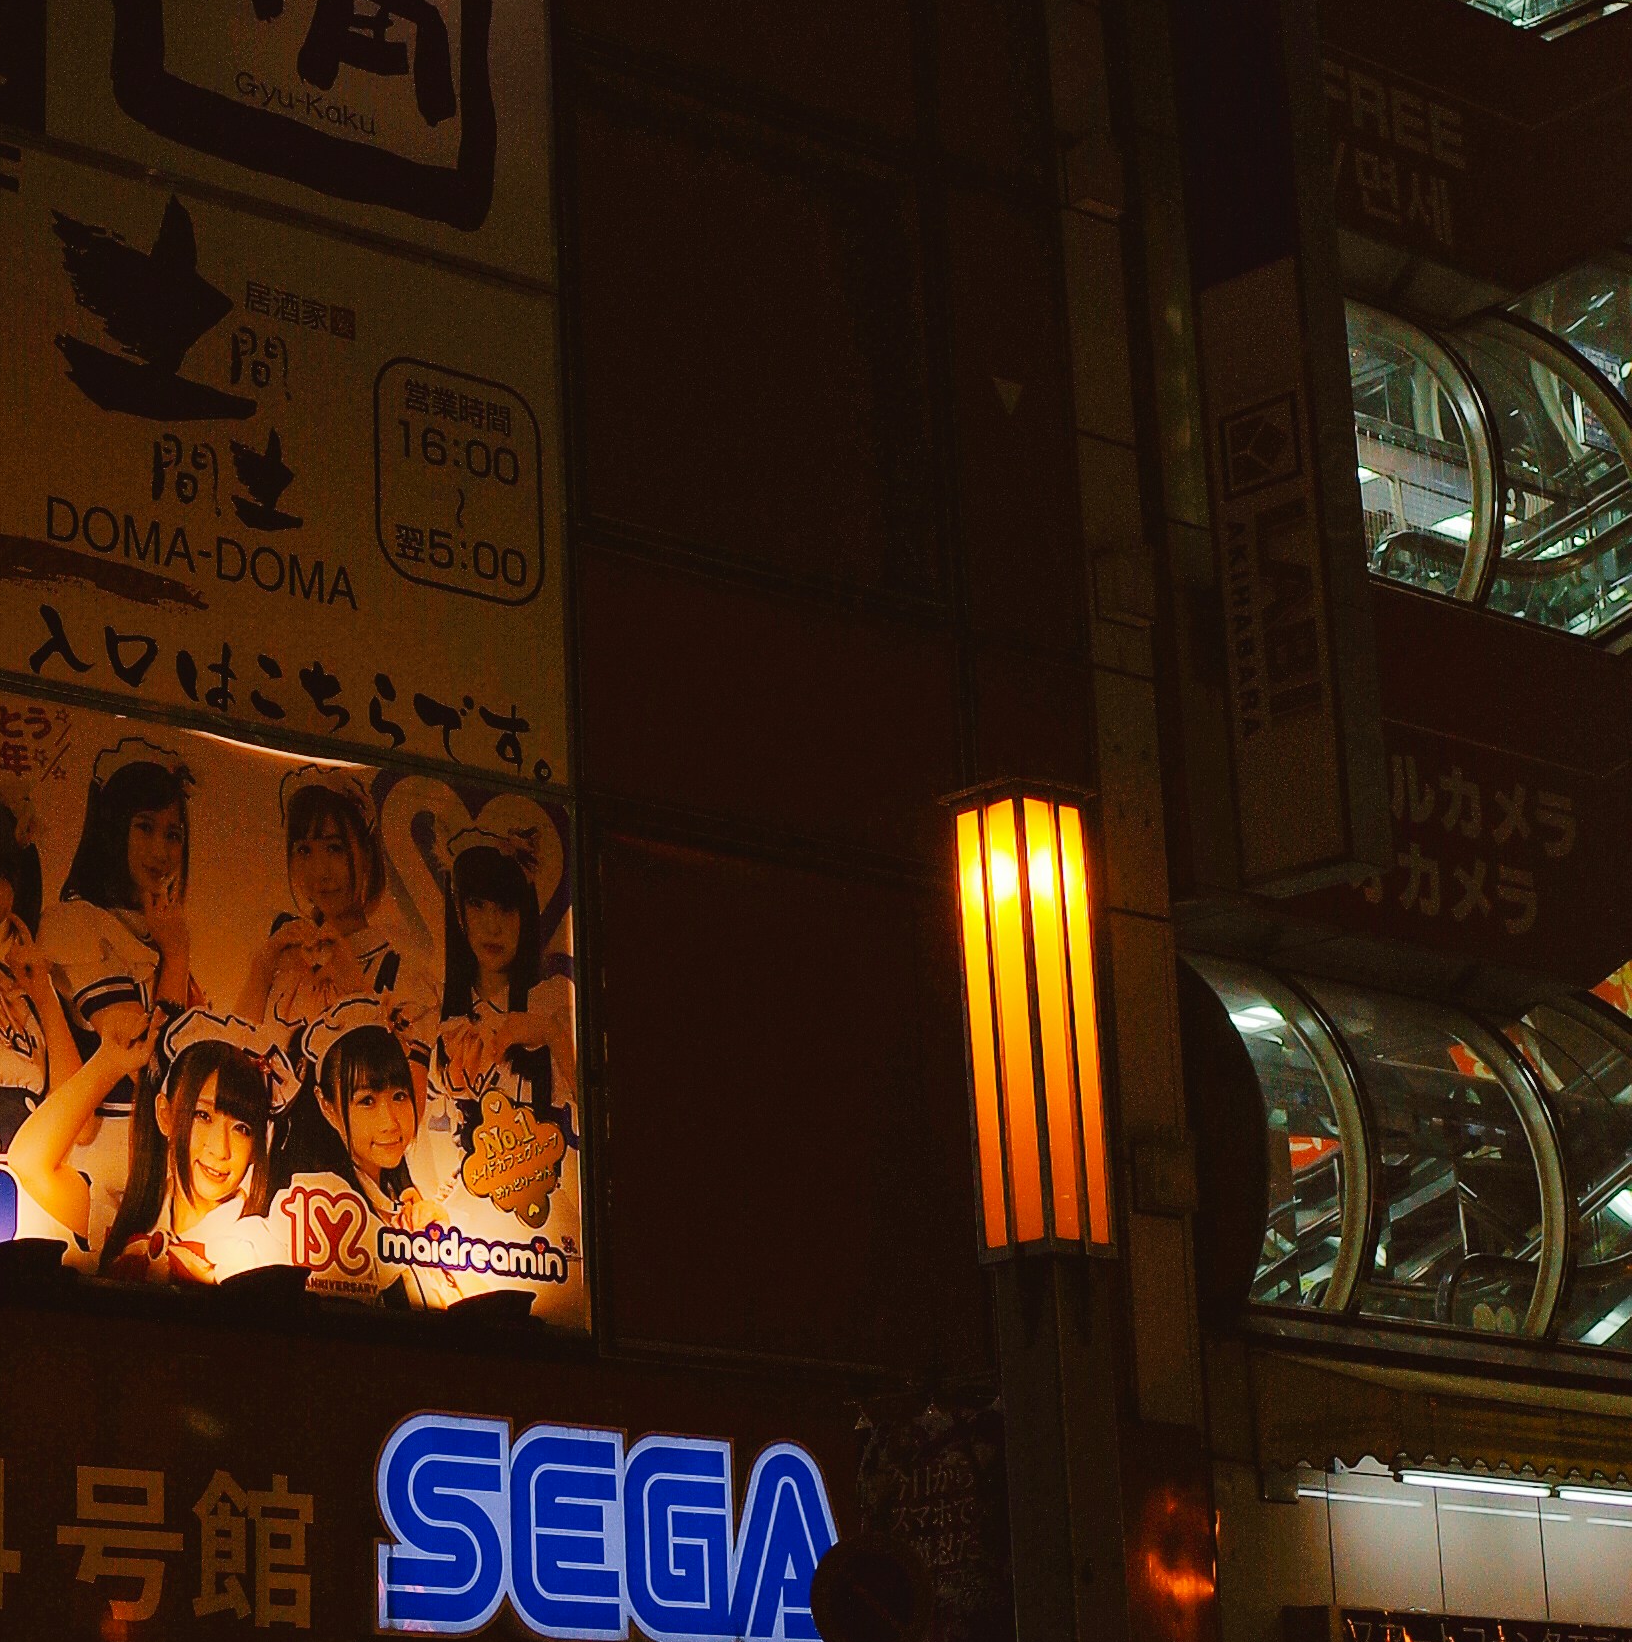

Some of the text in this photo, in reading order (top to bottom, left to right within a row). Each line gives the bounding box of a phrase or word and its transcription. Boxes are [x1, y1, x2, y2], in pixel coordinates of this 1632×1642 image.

[234, 70, 379, 136] Gyu-Kaku
[403, 377, 513, 436] 営業時間
[398, 420, 519, 487] 16:00
[47, 495, 359, 609] DOMA-DOMA
[394, 523, 527, 588] 翌5:00
[1226, 522, 1261, 738] AKIHABARA
[30, 603, 552, 783] 入口はこちらです。
[1390, 755, 1576, 859] ルカメラ
[1356, 843, 1539, 935] カメラ
[479, 1110, 536, 1160] No.1
[380, 1223, 568, 1282] maidreamin
